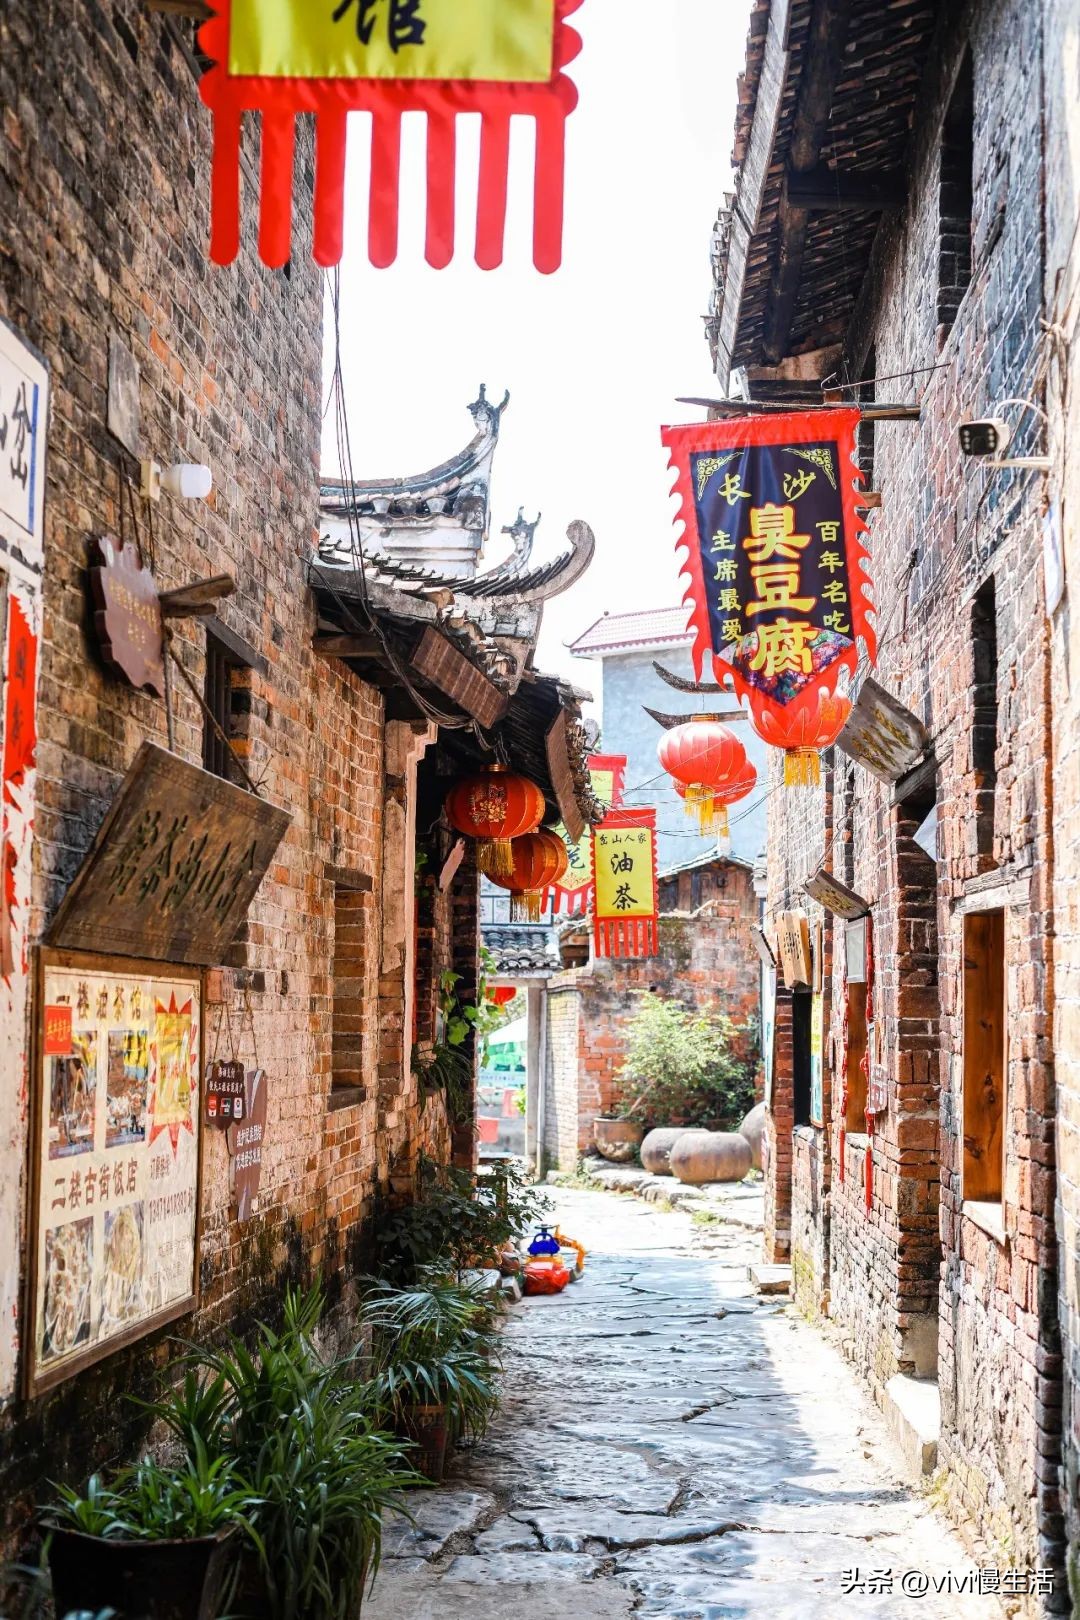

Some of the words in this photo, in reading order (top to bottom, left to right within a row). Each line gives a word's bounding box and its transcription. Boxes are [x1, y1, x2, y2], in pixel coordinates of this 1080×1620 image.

[717, 470, 817, 505] 长沙
[710, 529, 744, 642] 主席最爱
[743, 502, 817, 678] 臭豆腐
[815, 520, 850, 634] 百年名吃
[599, 832, 647, 846] 岔山人家
[610, 851, 638, 911] 油茶
[51, 1157, 139, 1212] 二楼古街饭店
